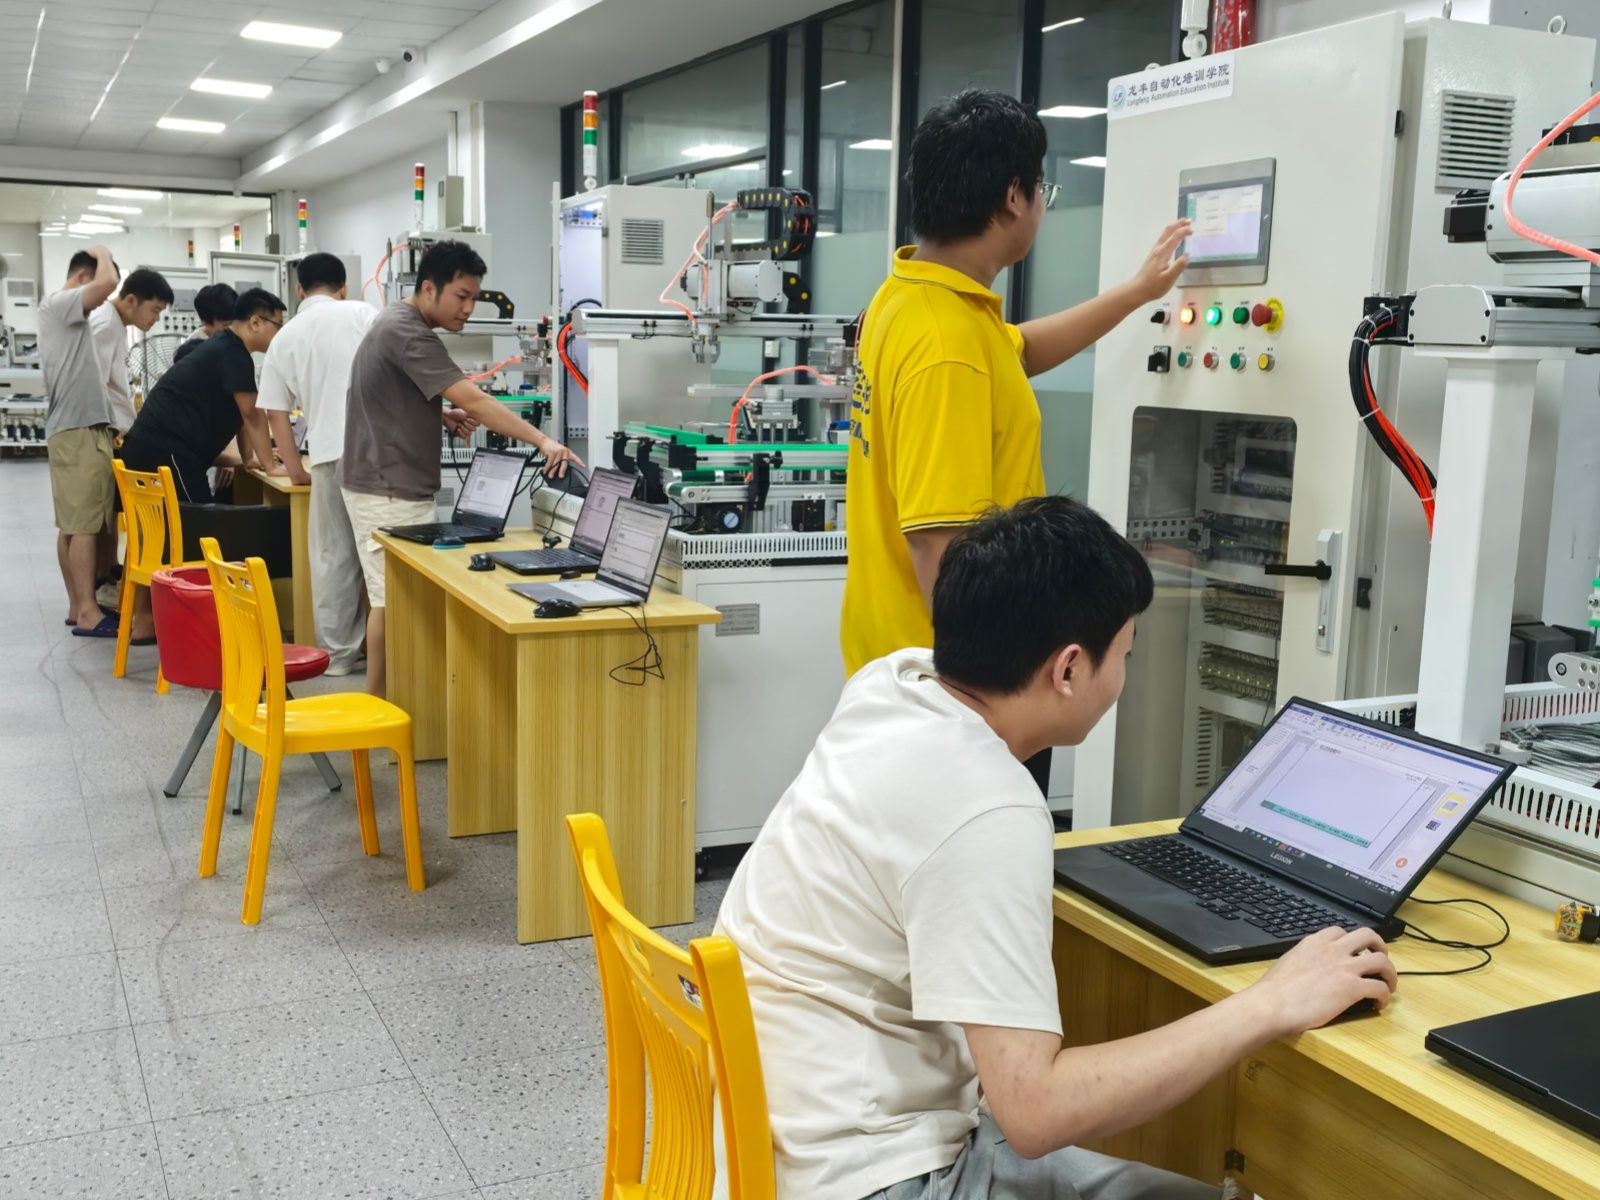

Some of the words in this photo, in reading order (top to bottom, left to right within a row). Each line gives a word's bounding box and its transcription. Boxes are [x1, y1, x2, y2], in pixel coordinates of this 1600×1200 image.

[1127, 63, 1230, 96] 龙丰自动化培训学院
[1151, 89, 1179, 101] Automation
[1180, 83, 1206, 95] Education
[1207, 78, 1230, 89] Institute
[1270, 851, 1293, 865] LEGION
